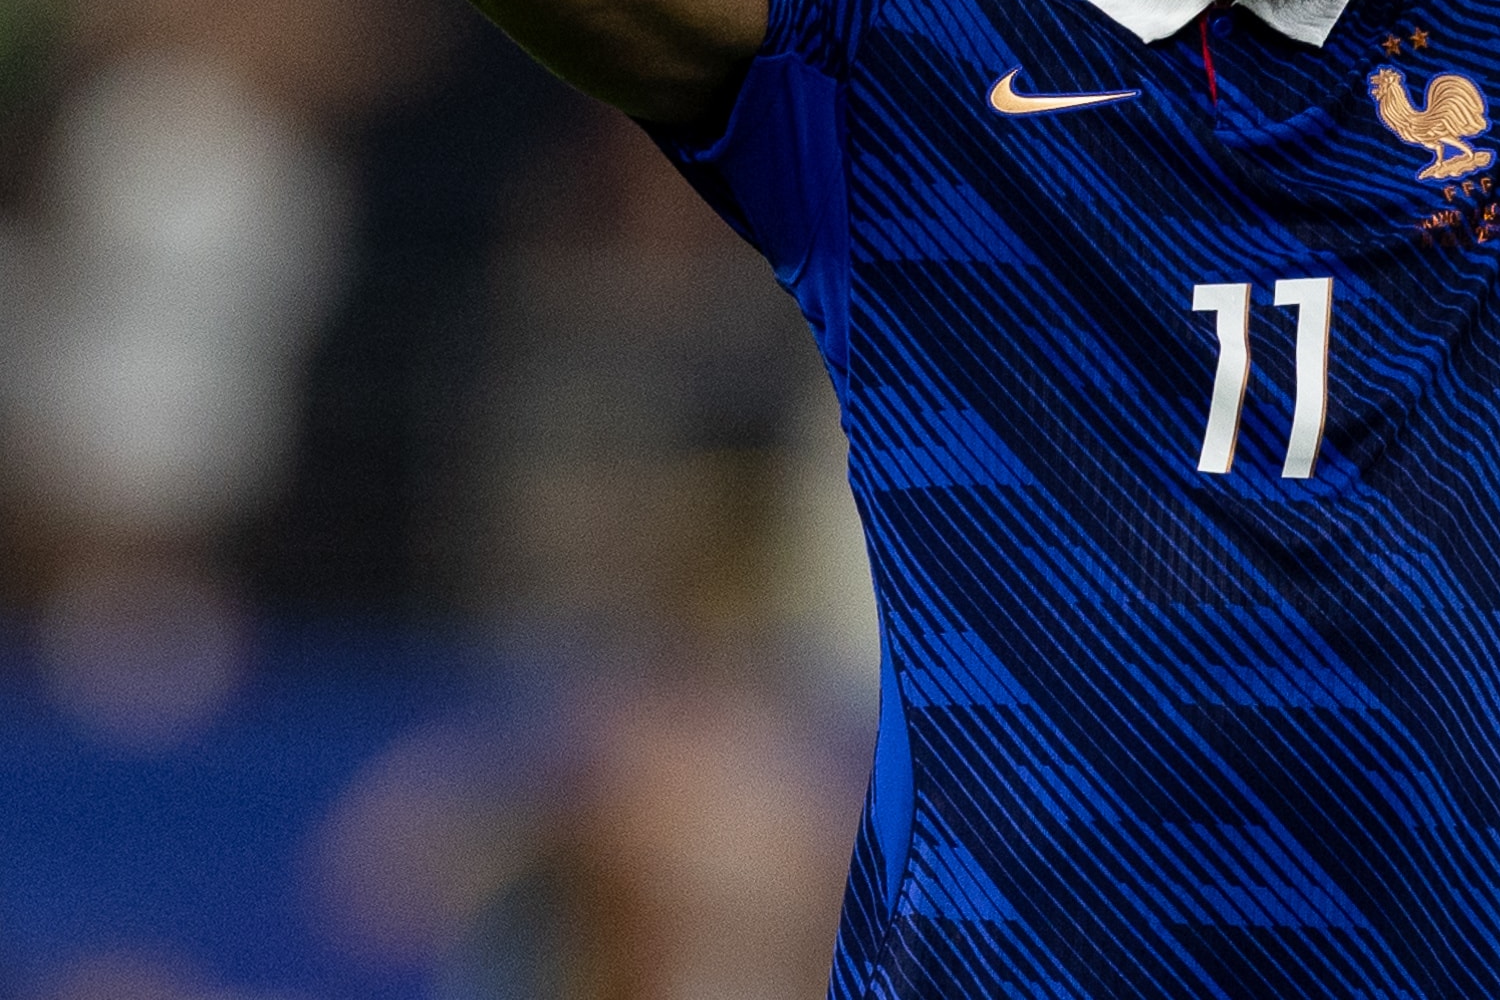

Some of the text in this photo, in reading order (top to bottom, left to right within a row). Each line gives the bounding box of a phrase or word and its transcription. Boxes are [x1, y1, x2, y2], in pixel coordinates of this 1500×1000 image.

[1443, 177, 1493, 202] FFF
[1415, 209, 1462, 230] RANC
[1192, 277, 1333, 478] 11
